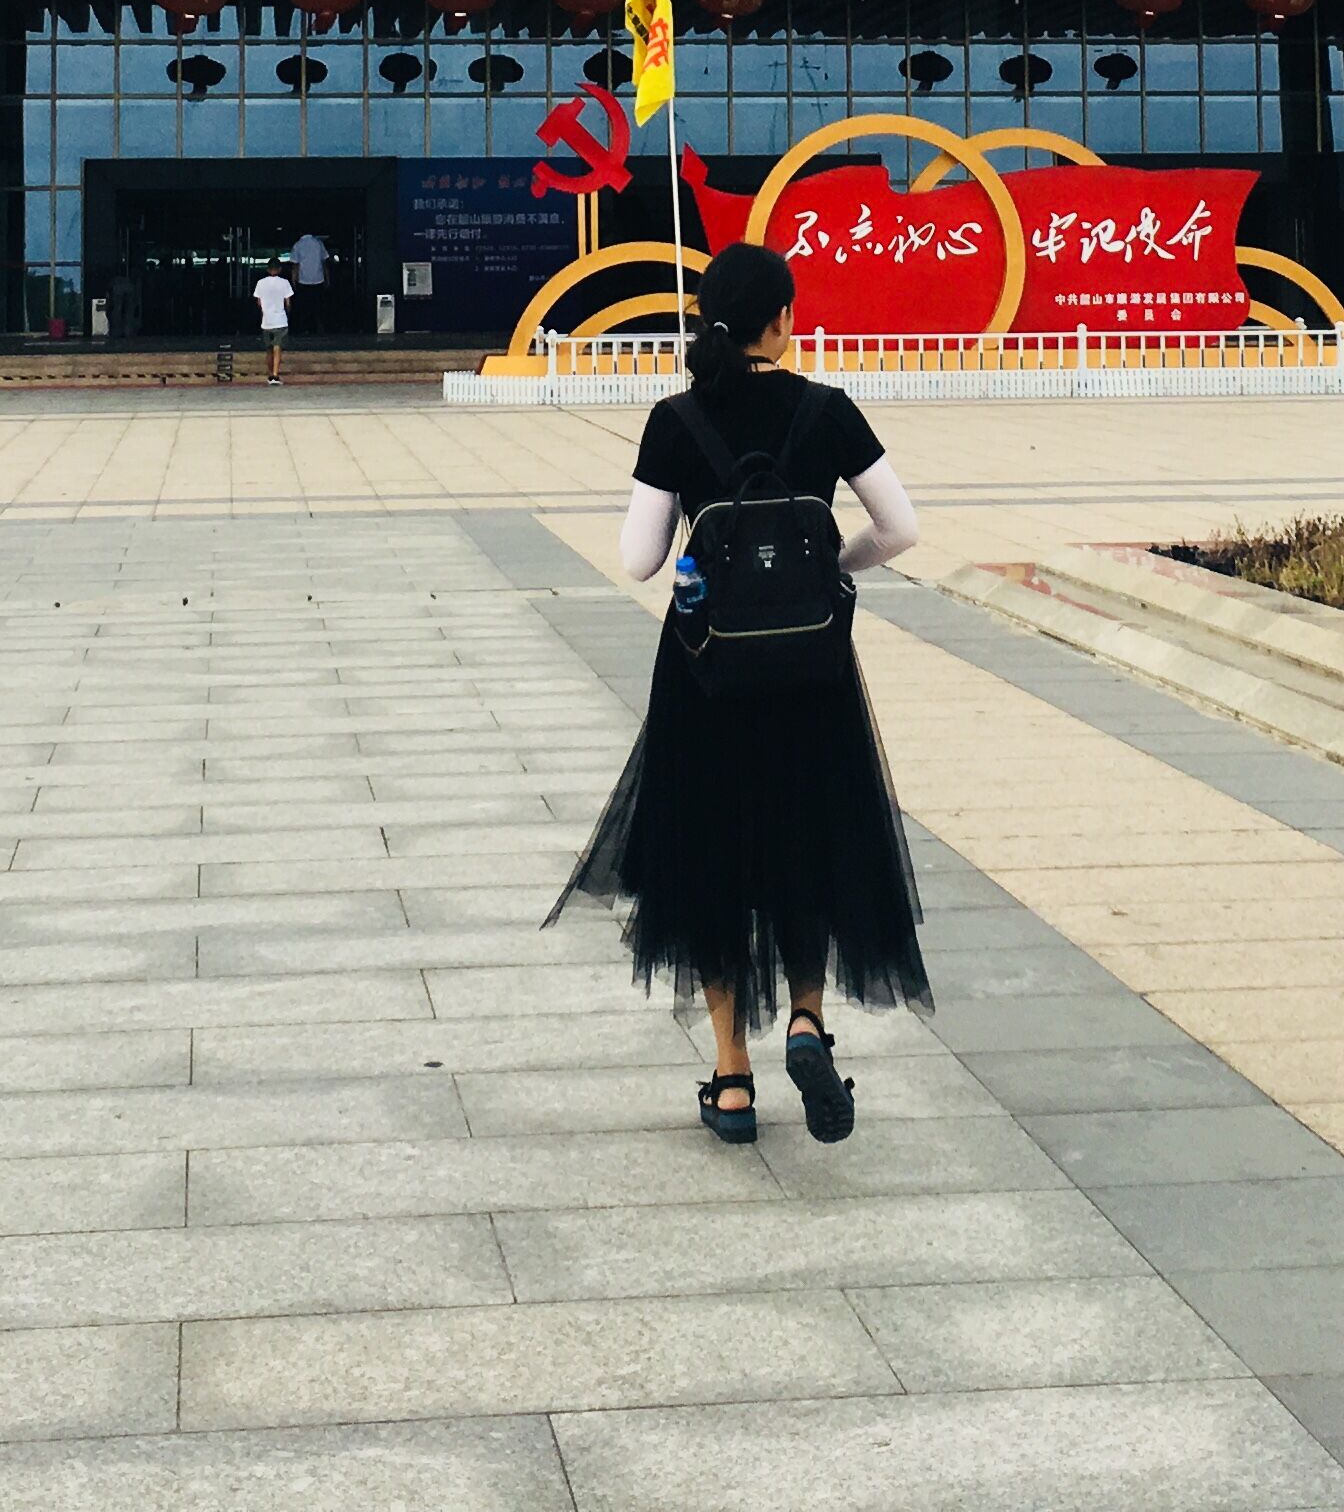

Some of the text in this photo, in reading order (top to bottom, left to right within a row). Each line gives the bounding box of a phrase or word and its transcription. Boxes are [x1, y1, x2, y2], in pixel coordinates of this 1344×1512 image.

[784, 199, 1214, 264] 不忘初心 牢记使命
[1116, 308, 1182, 322] 委员会
